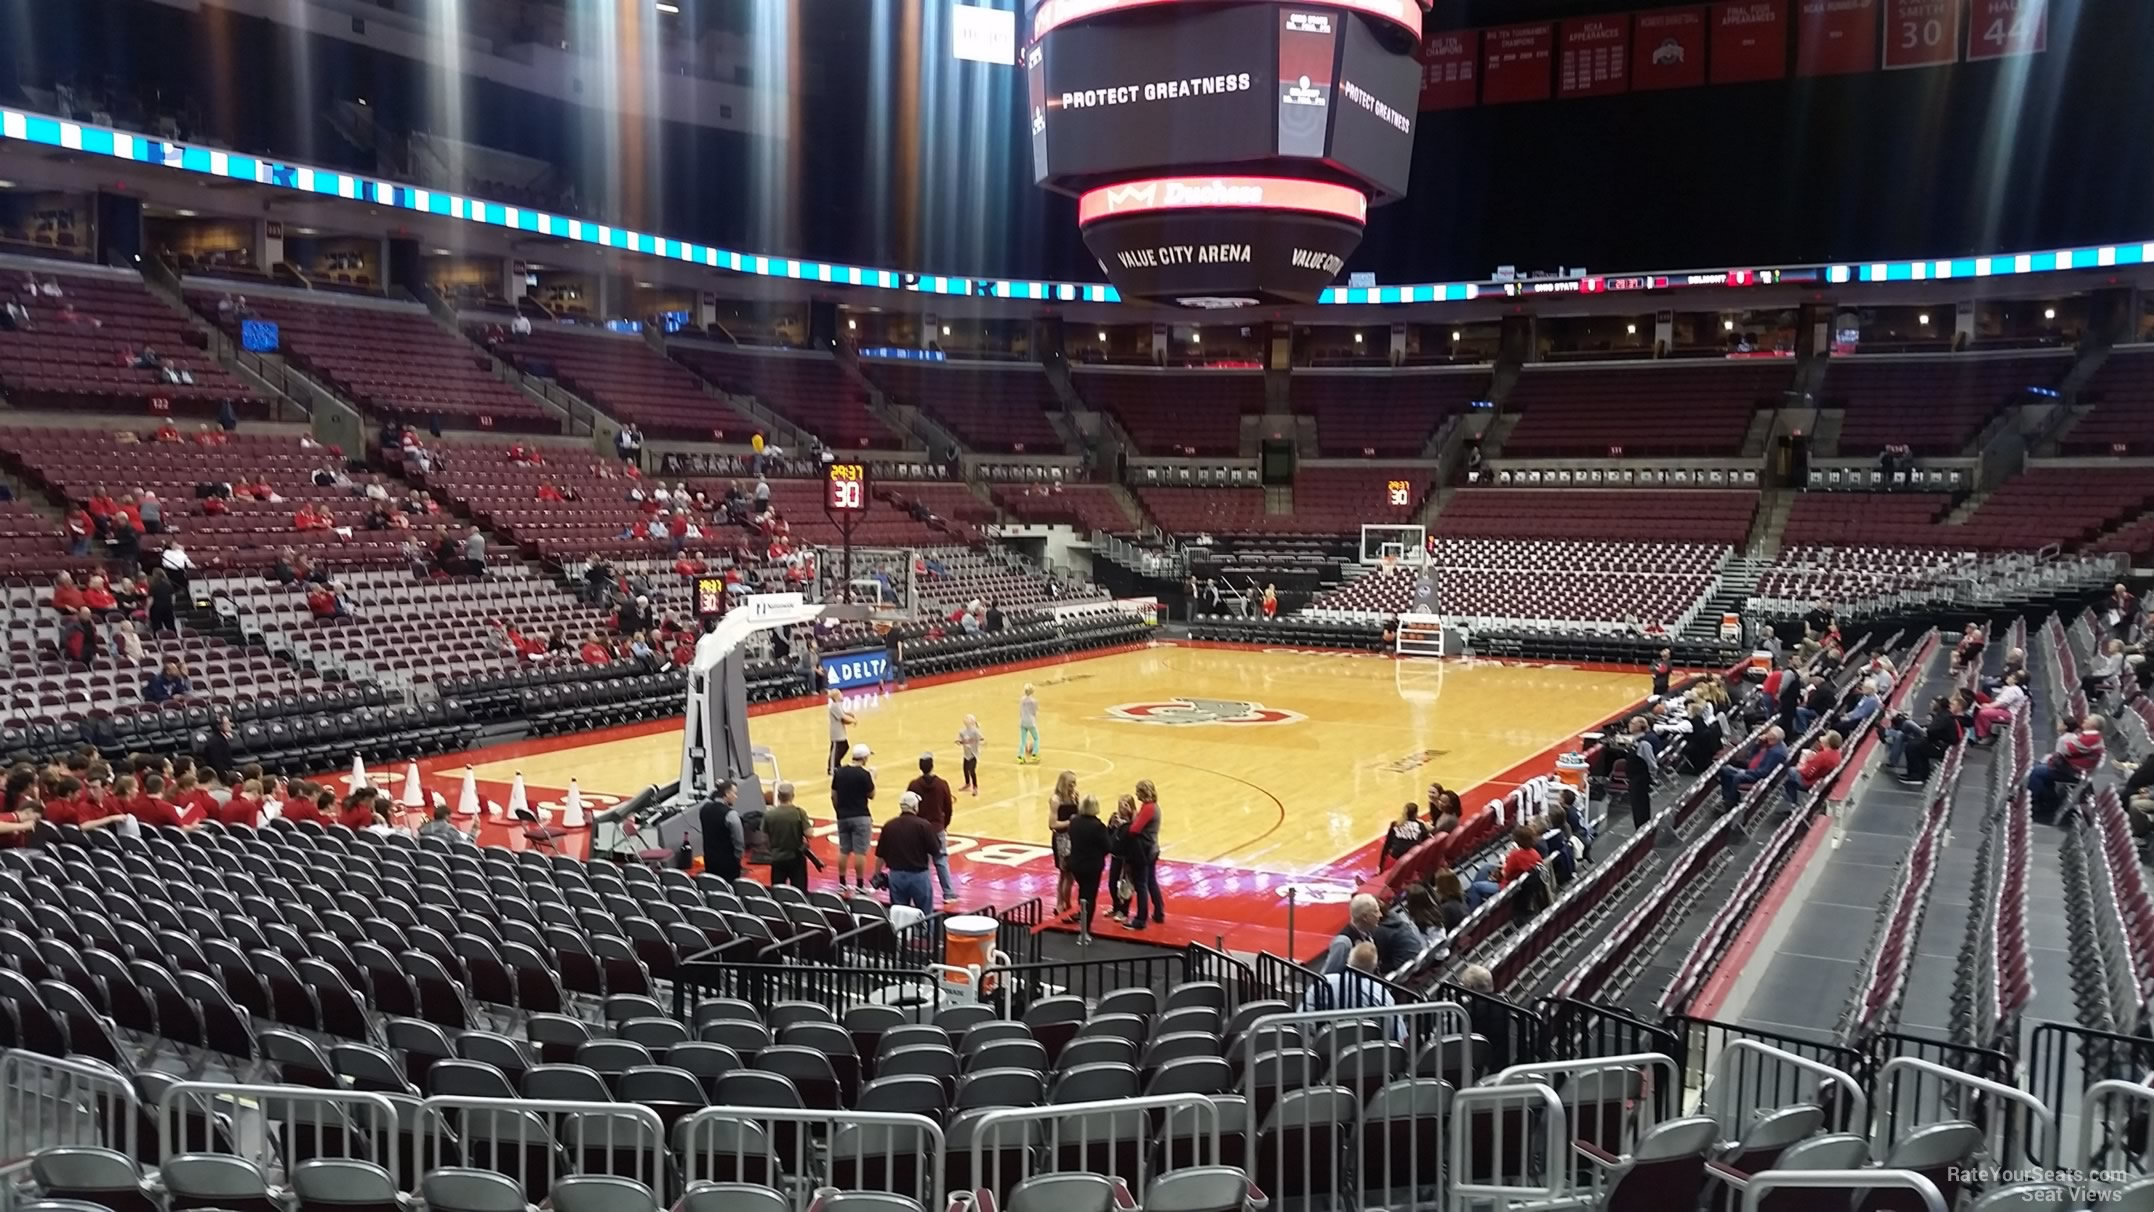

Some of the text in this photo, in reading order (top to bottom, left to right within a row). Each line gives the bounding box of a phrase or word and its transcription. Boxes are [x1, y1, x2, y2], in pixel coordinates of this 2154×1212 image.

[1901, 19, 1942, 48] 30
[1984, 17, 2030, 46] 44
[1063, 73, 1250, 109] PROTECT GREATNESS
[1345, 81, 1410, 134] PROTECT GREATNESS
[1117, 249, 1157, 269] VALUE
[1159, 246, 1193, 265] CITY
[1199, 244, 1251, 263] ARENA
[1292, 248, 1327, 269] VALUE
[152, 398, 169, 410] 122
[830, 465, 864, 481] 29:37
[834, 481, 859, 507] 30
[1391, 489, 1408, 505] 30
[702, 593, 717, 611] 30
